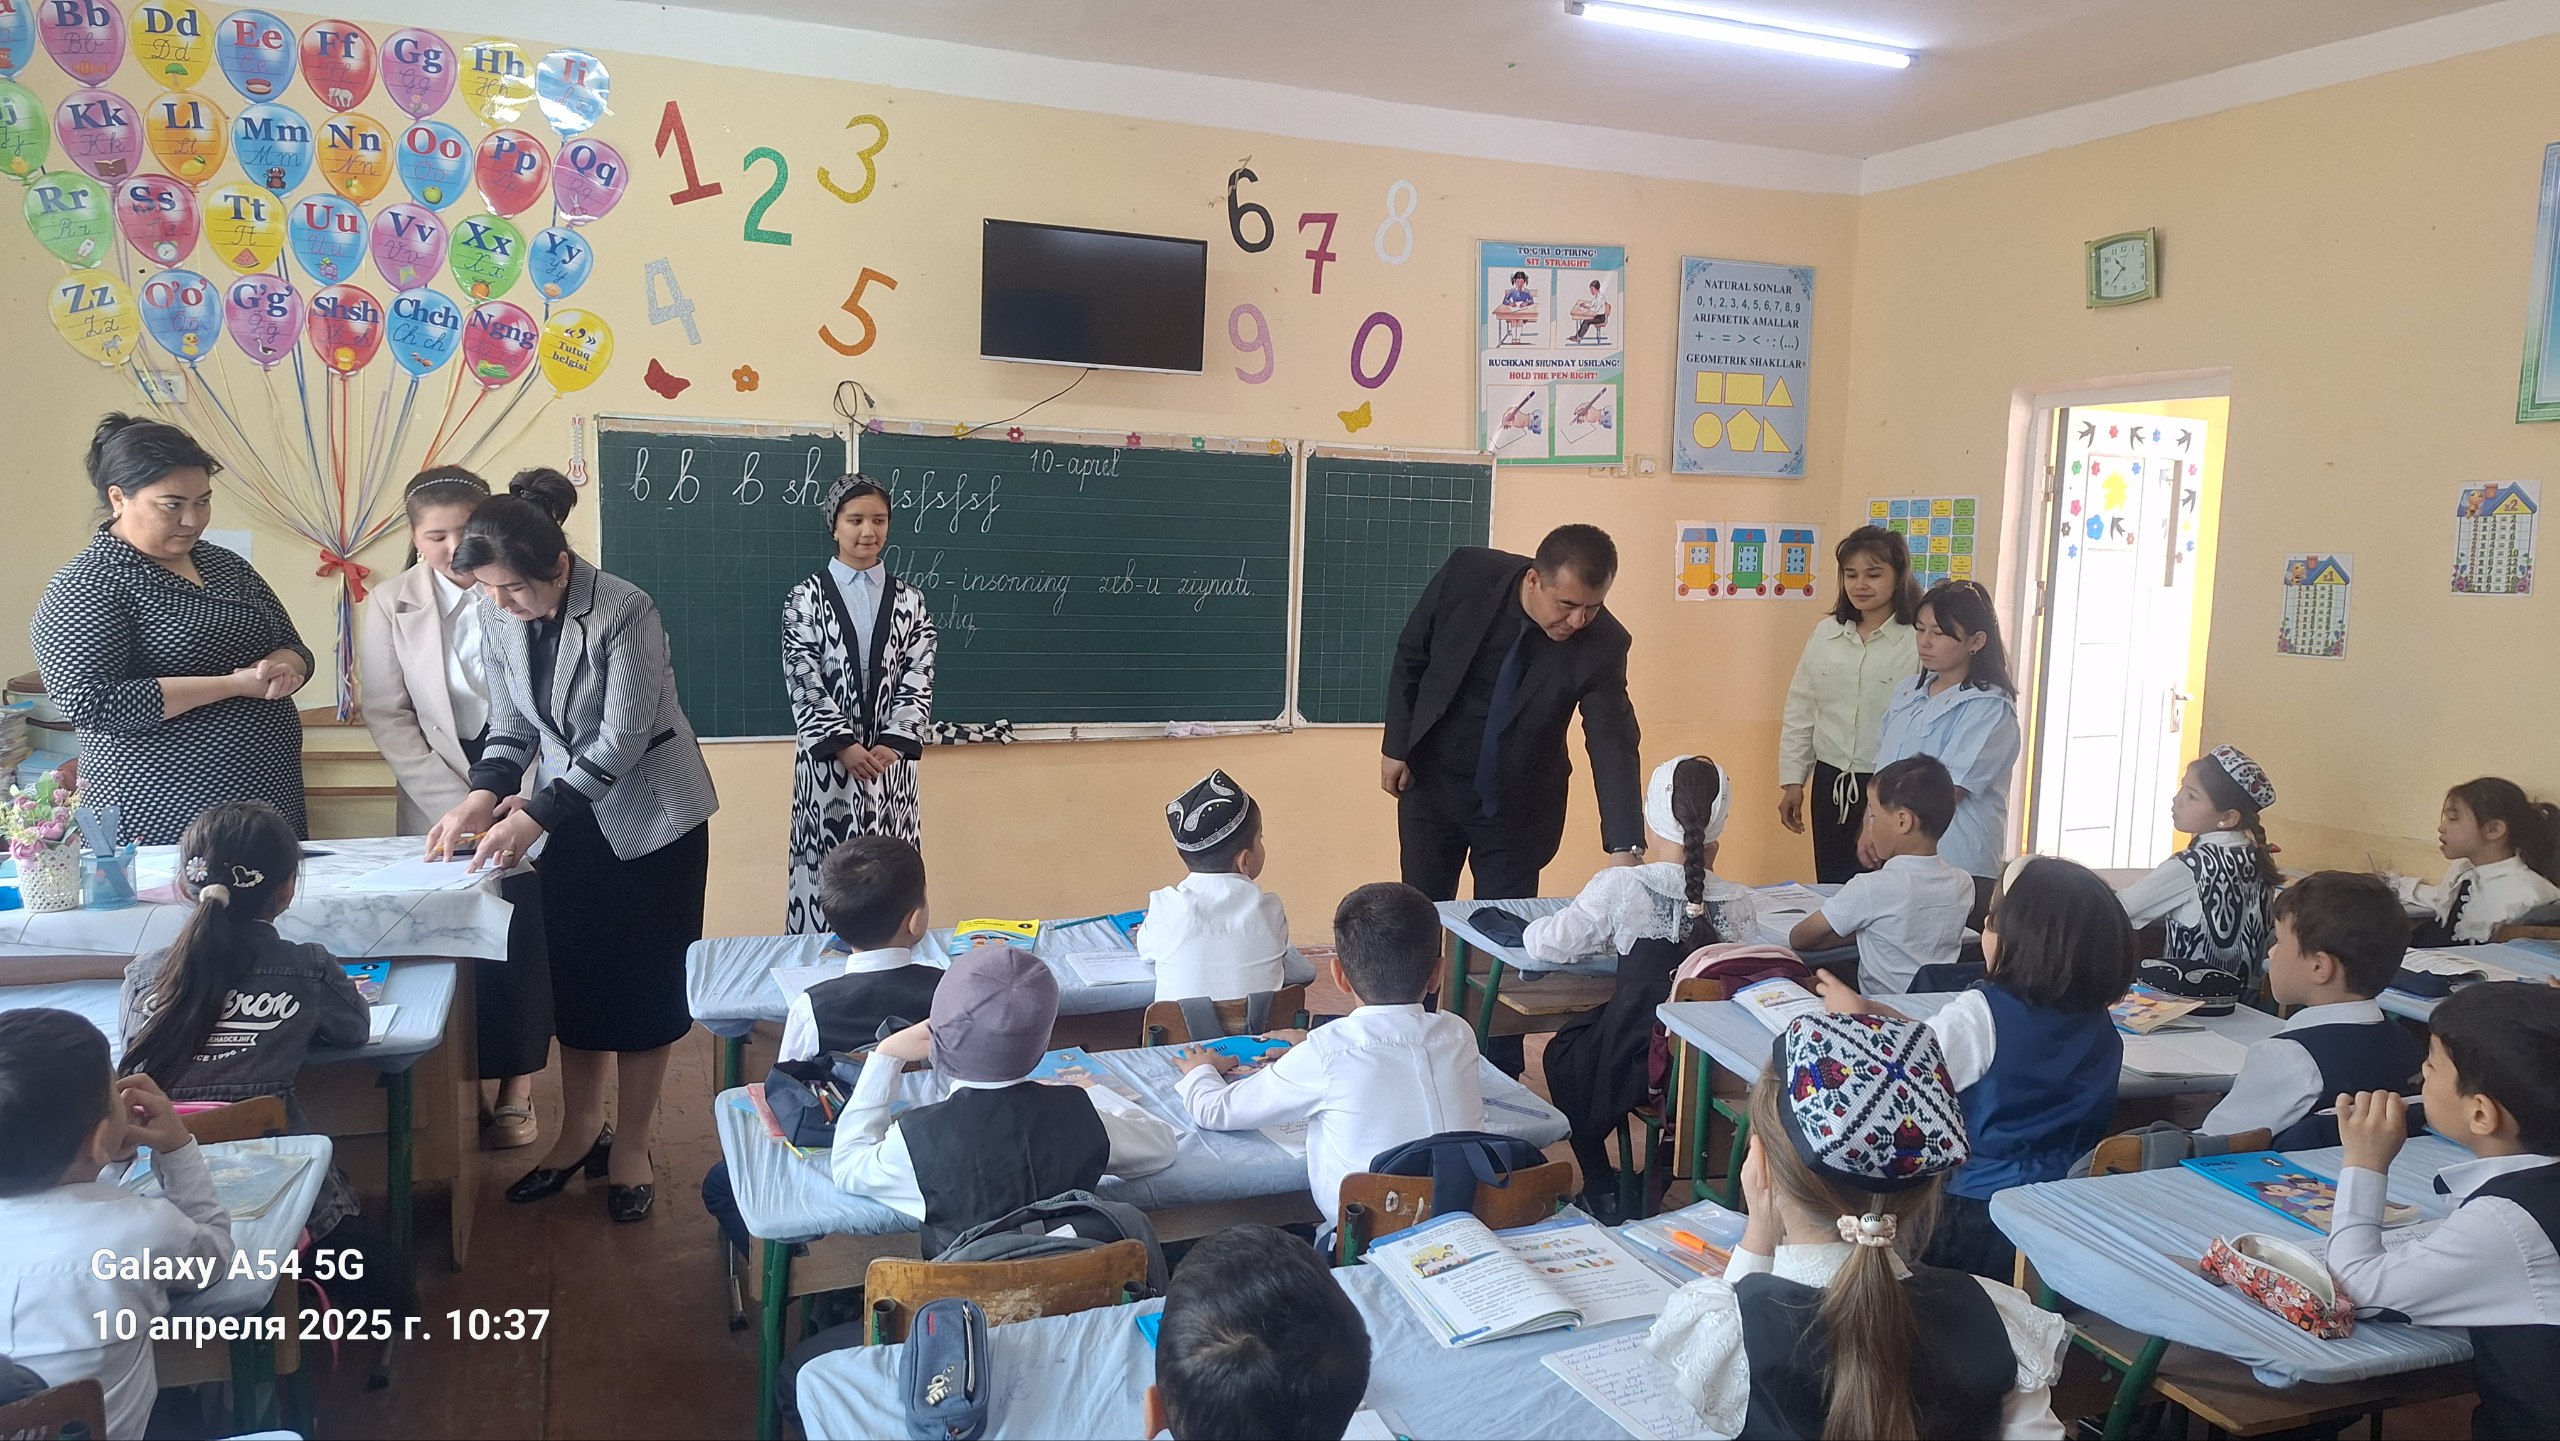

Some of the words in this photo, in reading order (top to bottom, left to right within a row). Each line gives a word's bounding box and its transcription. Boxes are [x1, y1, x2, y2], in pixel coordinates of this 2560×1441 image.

[55, 0, 110, 27] Bb
[143, 8, 201, 36] Dd
[232, 20, 283, 50] Ee
[316, 30, 358, 59] Ff
[394, 38, 443, 74] Gg
[472, 48, 525, 77] Hh
[560, 58, 586, 87] Ii
[67, 100, 128, 129] Kk
[162, 101, 204, 129] Ll
[241, 117, 310, 142] Mm
[327, 124, 382, 151] Nn
[406, 127, 462, 159] Oo
[490, 136, 537, 176] Pp
[571, 145, 617, 187] Qq
[655, 100, 723, 206] 1
[817, 114, 889, 204] 3
[34, 186, 89, 215] Rr
[130, 186, 176, 213] Ss
[224, 194, 267, 222] Tt
[744, 146, 792, 246] 2
[1228, 167, 1275, 253] 6
[303, 203, 360, 234] Uu
[389, 211, 436, 243] Vv
[1374, 179, 1418, 265] 8
[462, 221, 513, 257] Xx
[546, 231, 582, 265] Yy
[1299, 213, 1338, 294] 7
[1526, 258, 1540, 266] SIT
[1545, 259, 1590, 268] STRAIGHT!
[61, 283, 115, 314] Zz
[645, 257, 702, 345] 4
[1704, 279, 1751, 291] NATURAL
[1753, 282, 1792, 294] SONLAR
[313, 296, 379, 323] Shsh
[394, 298, 459, 330] Chch
[818, 267, 898, 356] 5
[1693, 313, 1750, 325] ARIFMETIK
[1752, 317, 1799, 329] AMALLAR
[1795, 303, 1801, 312] 9
[471, 310, 537, 350] Ngng
[1228, 303, 1274, 385] 9
[552, 351, 588, 372] belgisi
[559, 340, 591, 361] Tutuq
[1489, 359, 1533, 367] RUCHKANI
[1535, 359, 1576, 367] SHUNDAY
[1578, 359, 1620, 367] USHLANG!
[1686, 353, 1747, 366] GEOMETRIK
[1749, 357, 1802, 369] SHAKLLAR
[1509, 372, 1531, 380] HOLD
[1533, 372, 1549, 380] THE
[1571, 372, 1598, 380] RIGHT!
